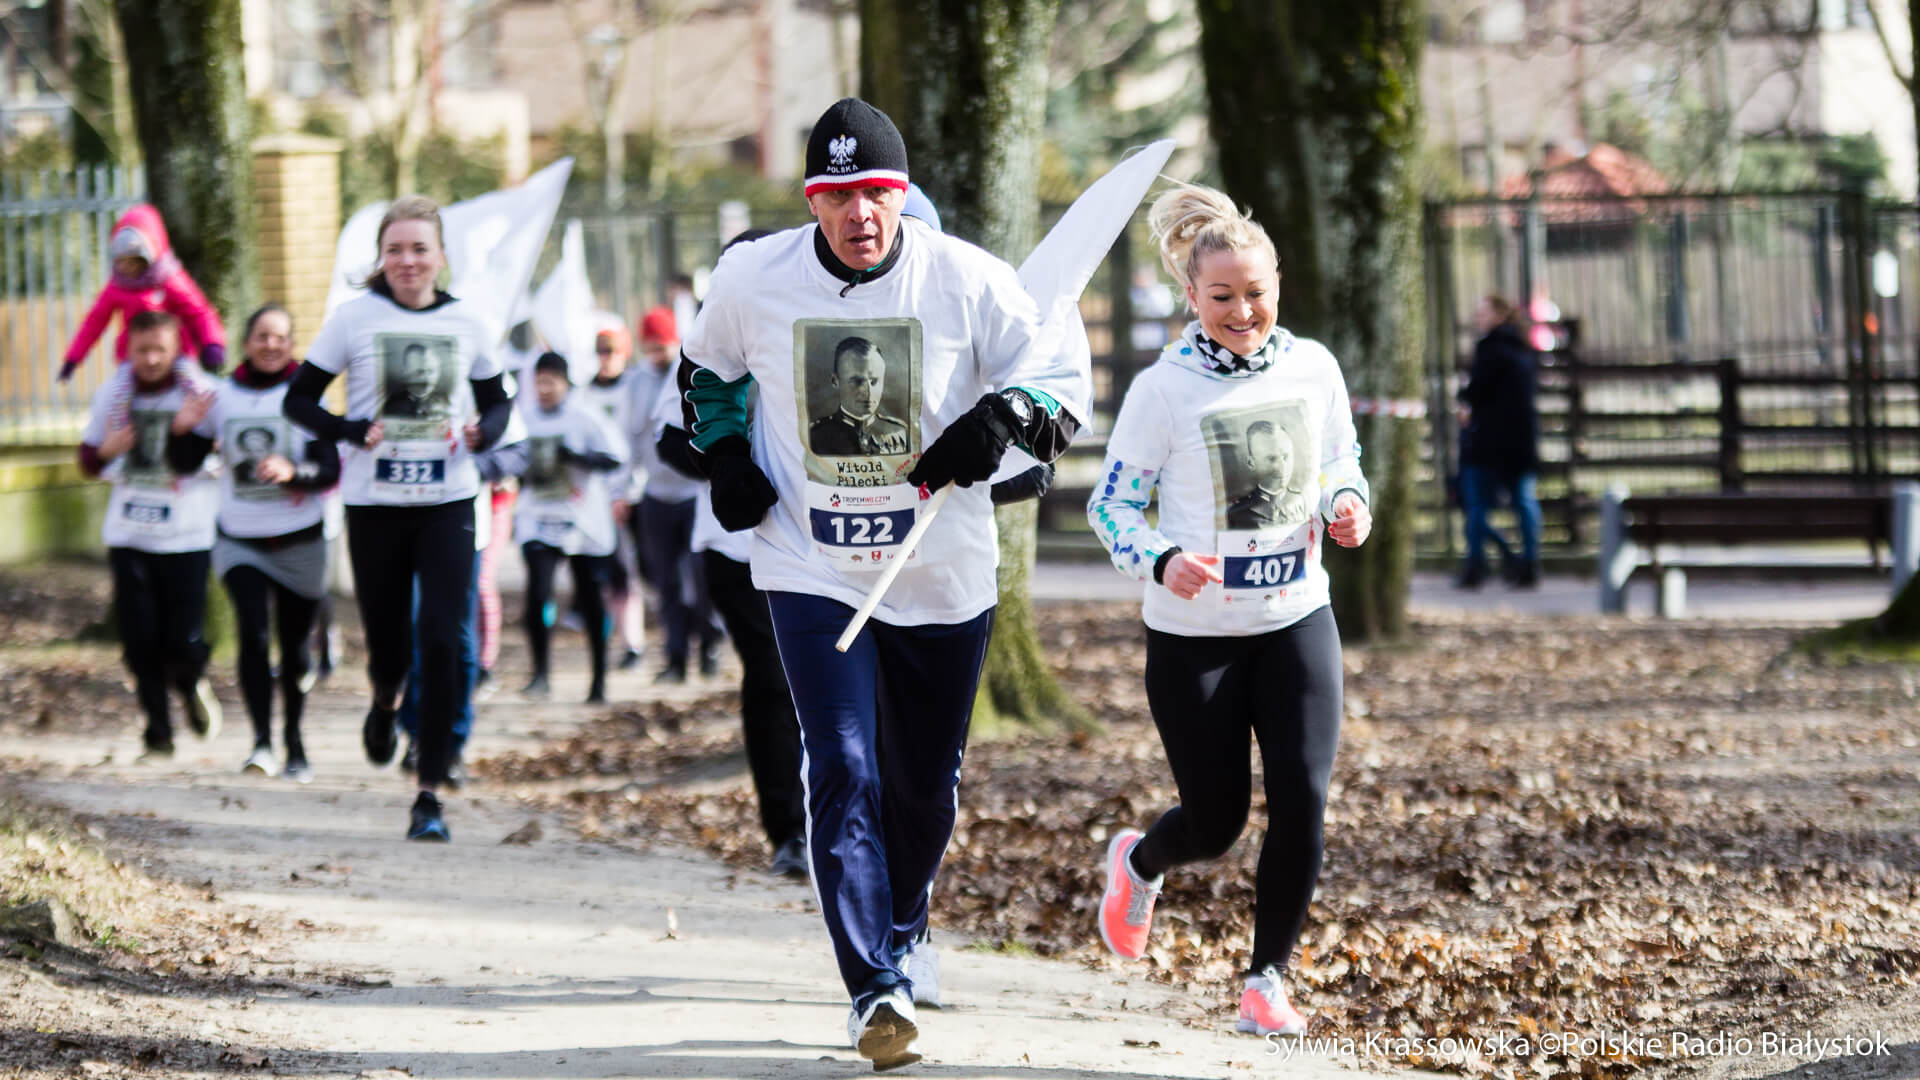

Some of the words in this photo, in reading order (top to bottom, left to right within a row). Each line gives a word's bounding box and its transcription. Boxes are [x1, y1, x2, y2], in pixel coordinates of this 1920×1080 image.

[826, 164, 859, 174] POLSKA
[389, 461, 434, 482] 332
[836, 461, 884, 474] Witold
[836, 476, 889, 488] Pilecki
[830, 516, 895, 545] 122
[1244, 555, 1297, 586] 407
